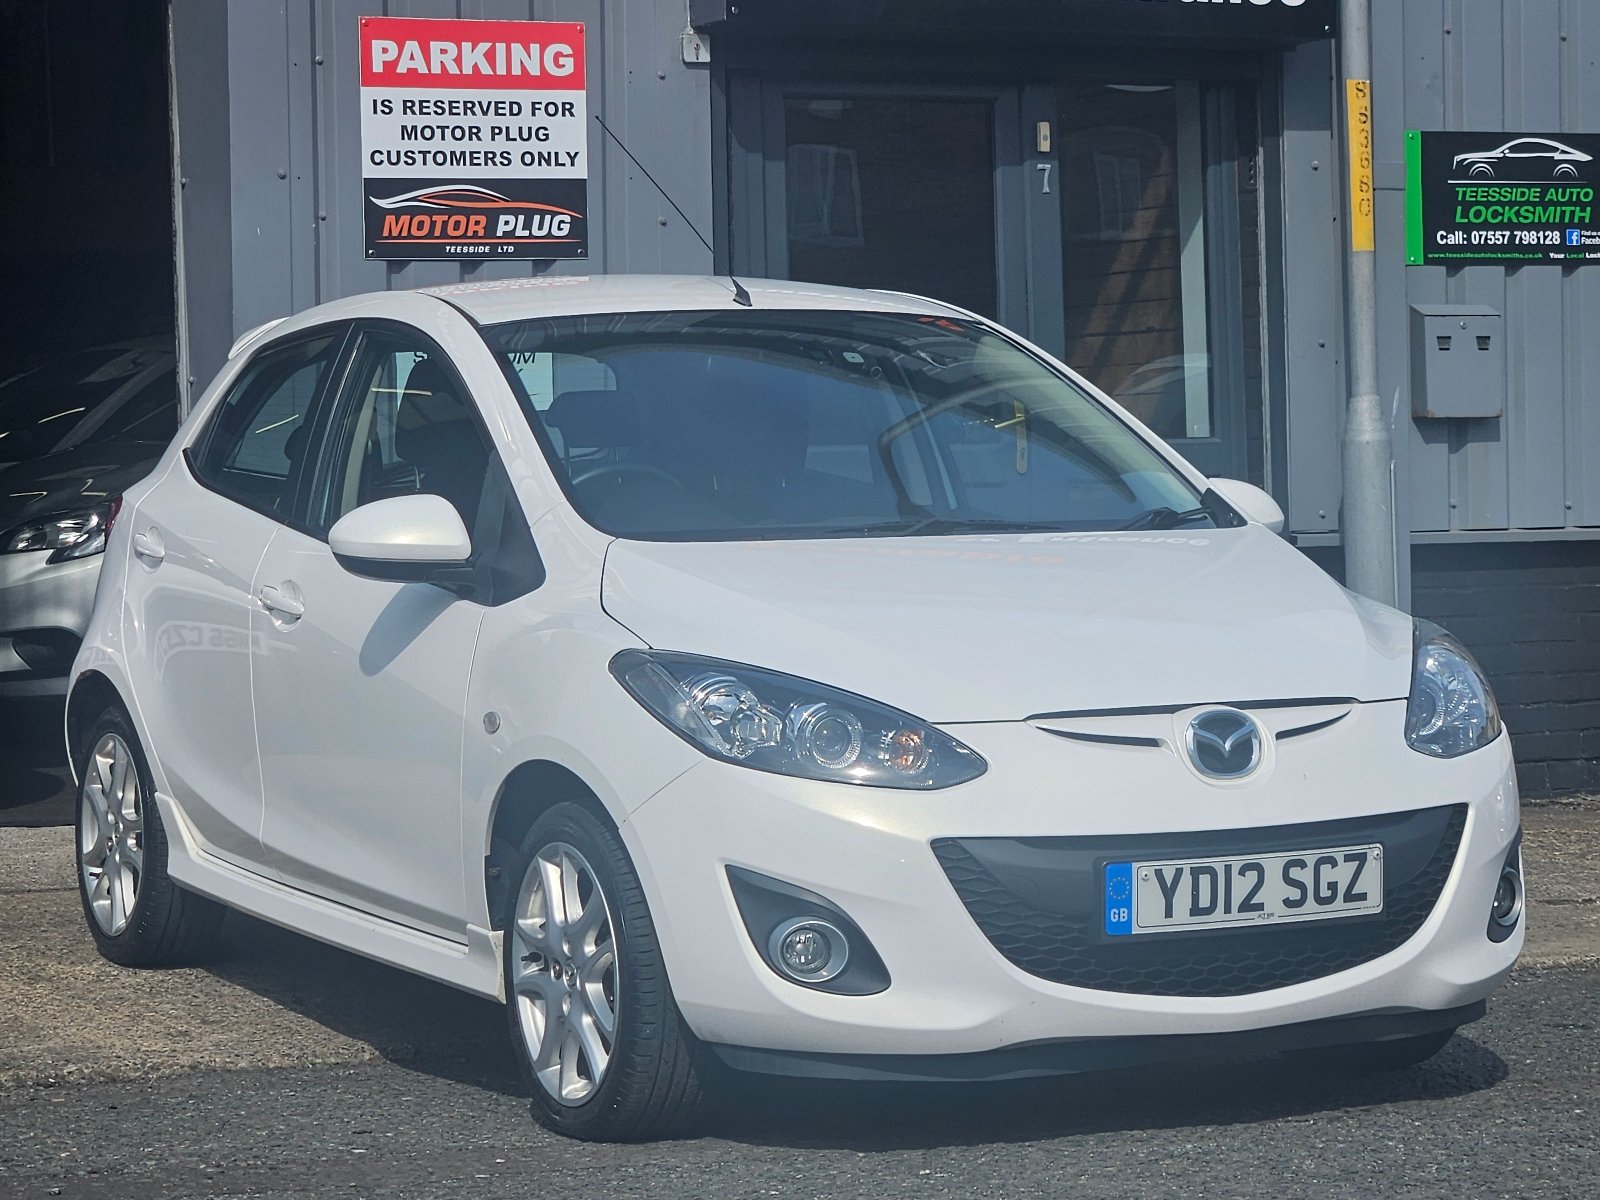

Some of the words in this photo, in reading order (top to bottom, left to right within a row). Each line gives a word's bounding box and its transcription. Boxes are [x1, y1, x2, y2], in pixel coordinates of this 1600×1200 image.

[371, 39, 574, 76] PARKING
[372, 99, 393, 115] IS
[402, 99, 522, 117] RESERVED
[531, 101, 575, 118] FOR
[401, 125, 482, 141] MOTOR
[490, 126, 550, 142] PLUG
[370, 150, 512, 167] CUSTOMERS
[520, 151, 580, 167] ONLY
[1036, 164, 1052, 194] 7
[1455, 187, 1541, 202] TEESSIDE
[1544, 188, 1594, 202] AUTO
[1455, 205, 1592, 224] LOCKSMITH
[382, 215, 486, 237] MOTOR
[496, 215, 571, 237] PLUG
[1436, 230, 1468, 245] Call:
[1471, 231, 1510, 245] 07557
[1514, 231, 1561, 245] 798128
[1154, 861, 1265, 919] YD12
[1281, 851, 1367, 909] SGZ
[1110, 908, 1128, 923] GB
